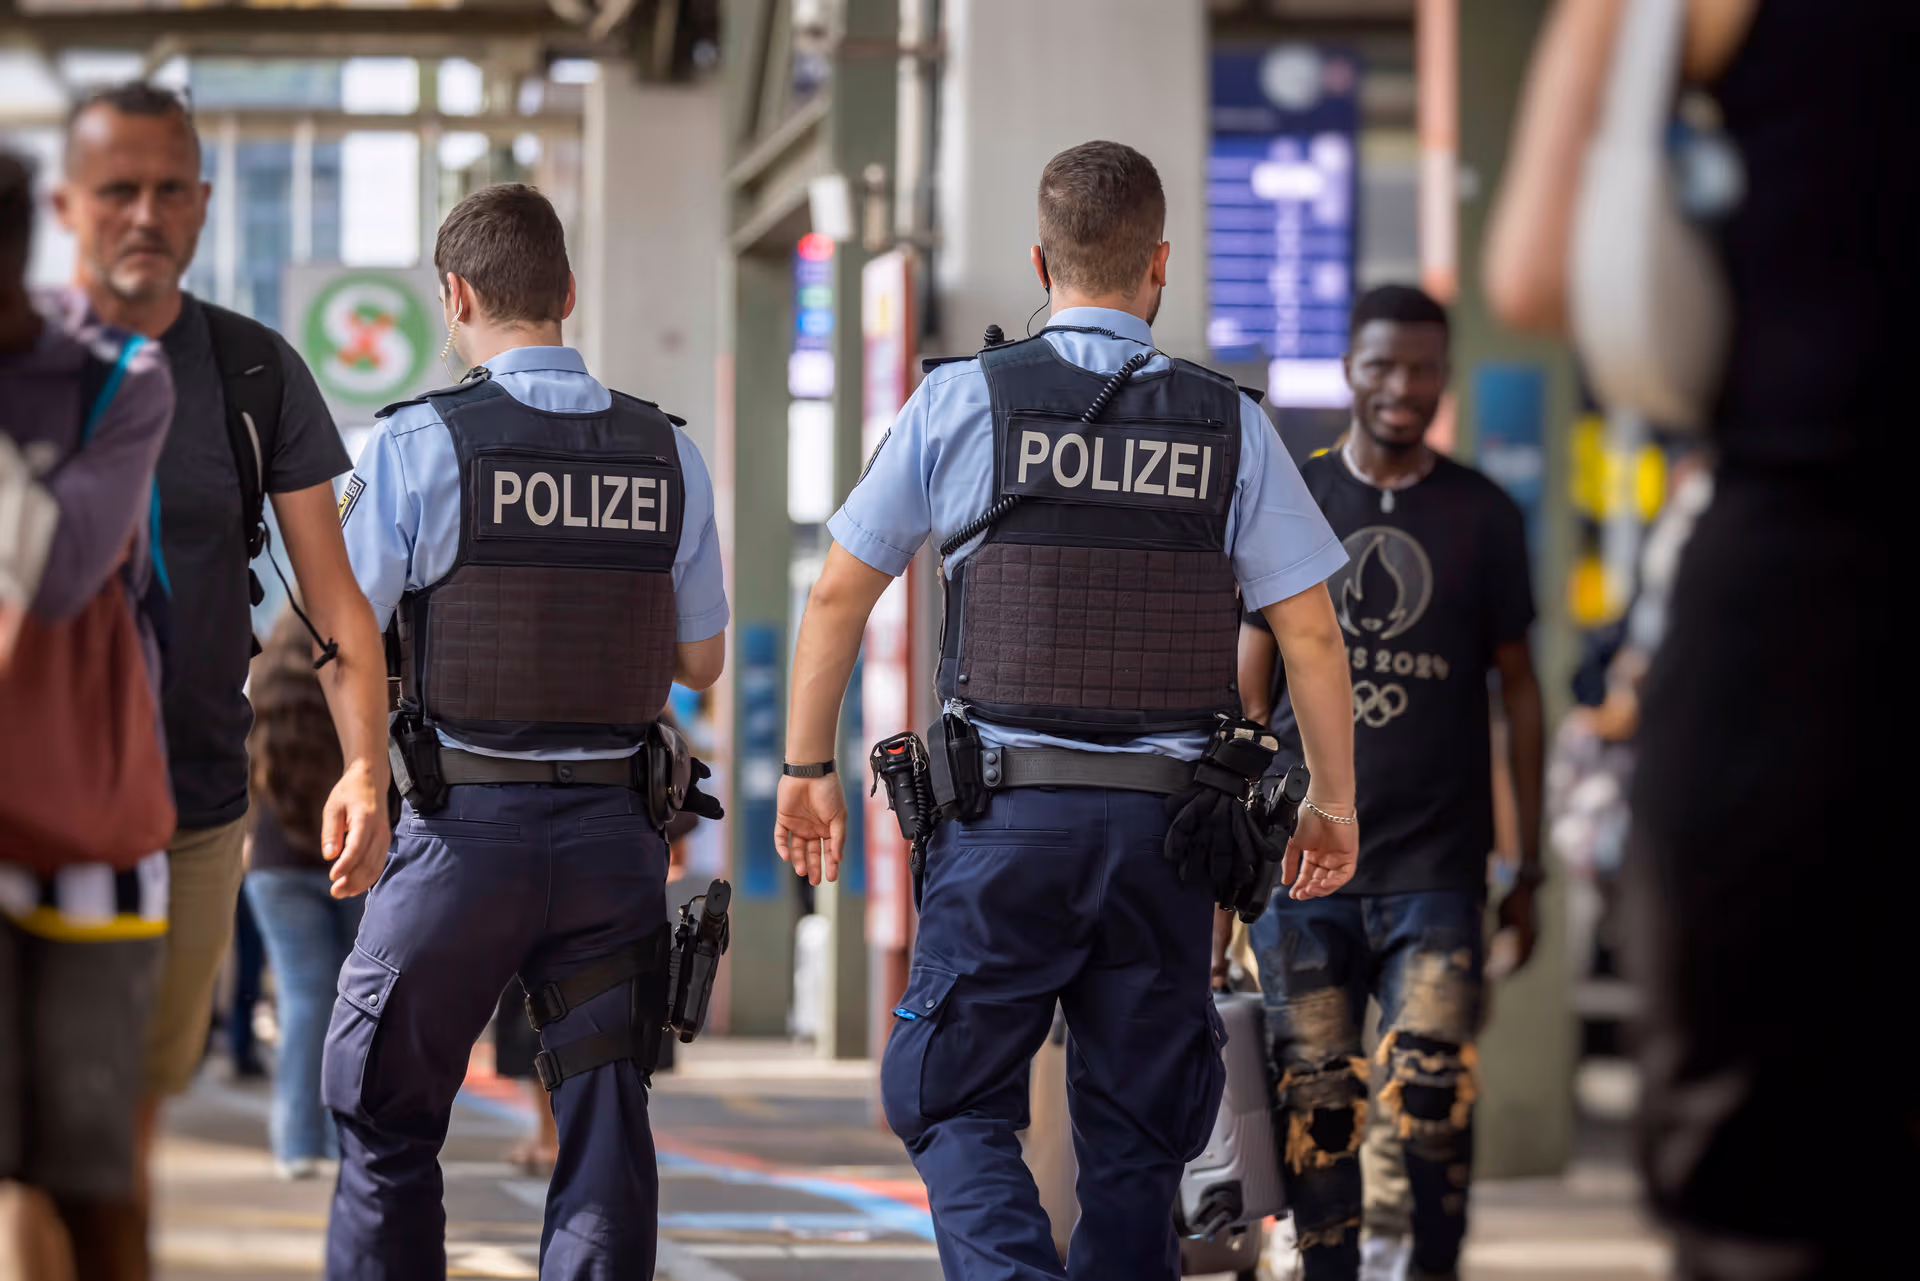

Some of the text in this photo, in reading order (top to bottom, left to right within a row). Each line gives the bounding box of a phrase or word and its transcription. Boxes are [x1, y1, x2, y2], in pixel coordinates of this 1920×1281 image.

[322, 283, 415, 391] S
[1018, 430, 1212, 499] POLIZEI
[493, 471, 668, 532] POLIZEI
